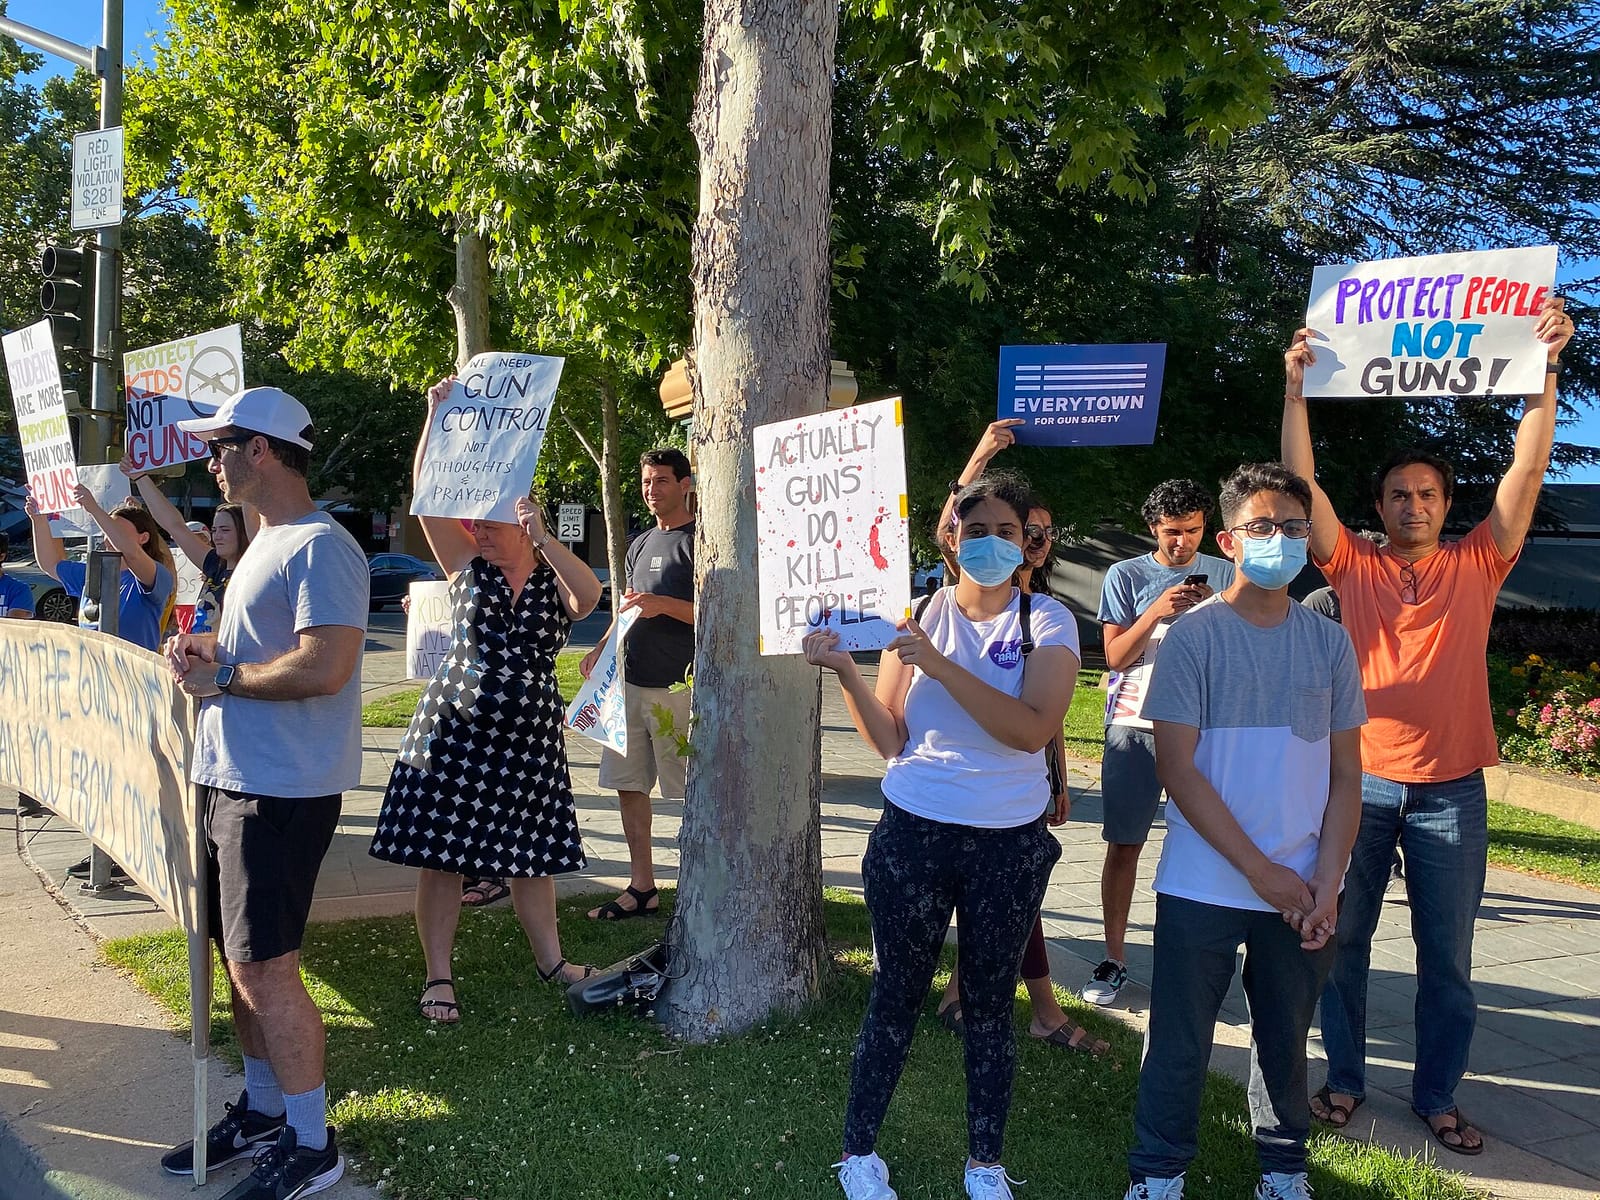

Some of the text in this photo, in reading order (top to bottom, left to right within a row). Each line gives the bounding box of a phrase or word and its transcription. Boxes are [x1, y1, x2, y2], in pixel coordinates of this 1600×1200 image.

[88, 139, 109, 155] RED
[76, 168, 120, 188] VIOLATION
[83, 155, 113, 172] LIGHT
[82, 186, 113, 208] $281
[91, 207, 107, 218] FINE
[1335, 274, 1549, 324] PROTECT PEOPLE
[20, 327, 34, 352] MY
[1391, 320, 1485, 359] NOT
[9, 348, 58, 391] STUDENTS
[125, 340, 197, 372] PROTECT
[470, 357, 532, 368] WE NEED
[126, 364, 183, 401] KIDS
[464, 373, 532, 399] GUN
[1360, 357, 1512, 395] GUNS!
[16, 383, 62, 418] ARE MORE
[128, 395, 168, 432] NOT
[1013, 395, 1145, 413] EVERYTOWN
[20, 415, 68, 446] IMPORTANT
[441, 406, 548, 432] CONTROL
[1034, 414, 1121, 426] FOR GUN SAFETY
[25, 441, 74, 472] THAN YOUR
[130, 424, 209, 470] GUNS
[463, 442, 489, 453] NOT
[769, 415, 883, 469] ACTUALLY
[433, 460, 514, 474] THOUGHTS
[32, 467, 78, 511] GUNS
[433, 485, 499, 503] PRAYERS
[786, 466, 861, 506] GUNS
[561, 524, 581, 537] 25
[808, 511, 838, 546] DO
[787, 549, 853, 588] KILL
[418, 594, 452, 624] KIDS
[775, 588, 881, 630] PEOPLE
[414, 622, 450, 651] LIVE
[29, 637, 71, 720] THE
[28, 721, 62, 806] YOU
[70, 747, 115, 850] FROM
